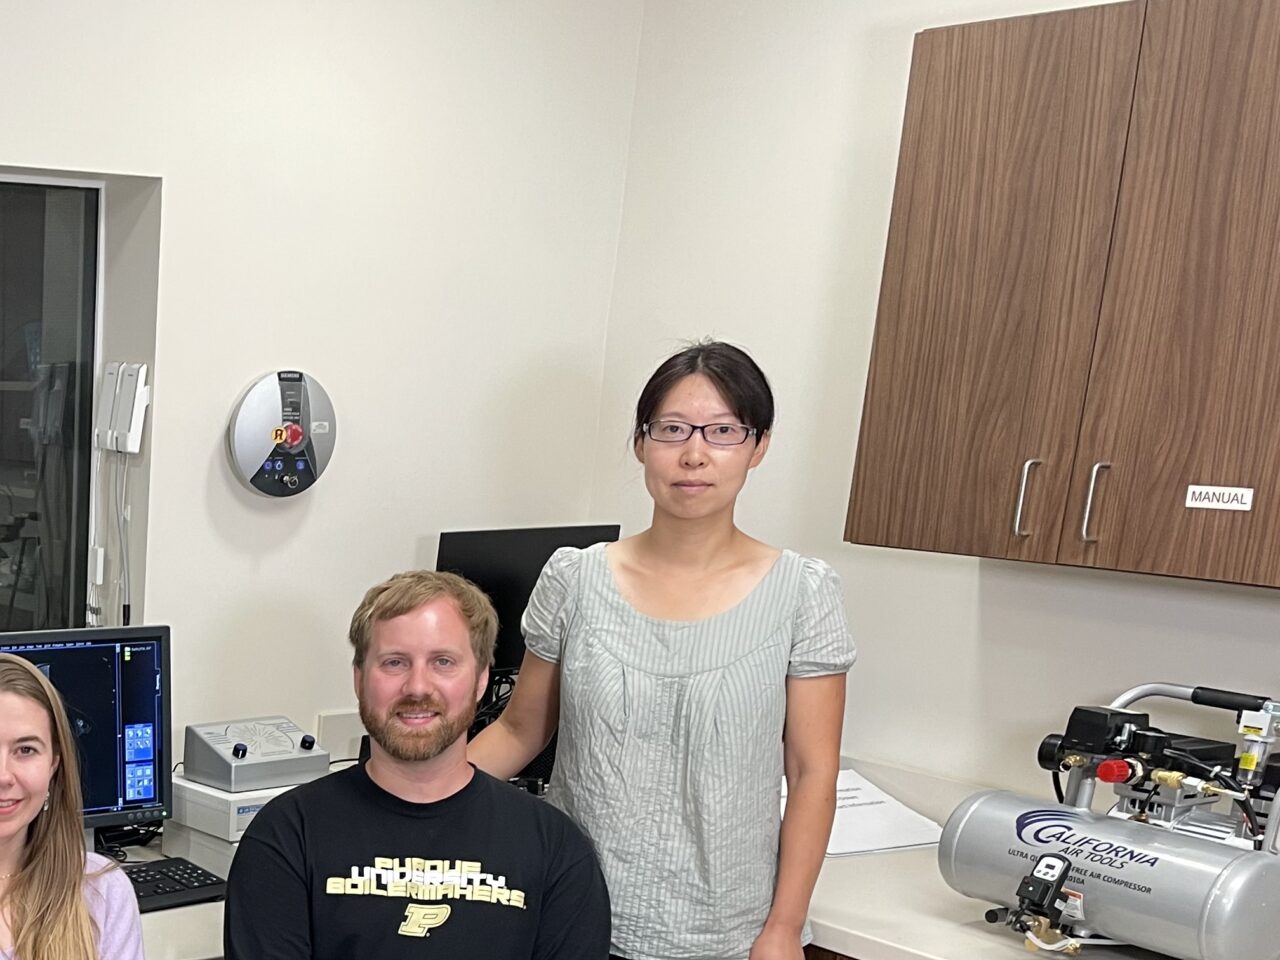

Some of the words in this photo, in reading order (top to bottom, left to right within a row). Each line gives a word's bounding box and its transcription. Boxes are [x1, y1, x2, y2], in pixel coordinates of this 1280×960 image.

[1190, 490, 1248, 505] MANUAL
[1008, 848, 1028, 860] ULTRA
[1033, 824, 1160, 867] CALIFORNIA
[374, 856, 482, 873] PURDUE
[1058, 846, 1084, 858] AIR
[1084, 851, 1129, 870] TOOLS
[351, 866, 506, 889] UNIVERSITY
[1071, 866, 1089, 877] FREE
[1089, 871, 1101, 880] AIR
[1102, 874, 1152, 895] COMPRESSOR
[326, 877, 526, 909] BOILERMAKERS
[398, 903, 451, 937] P
